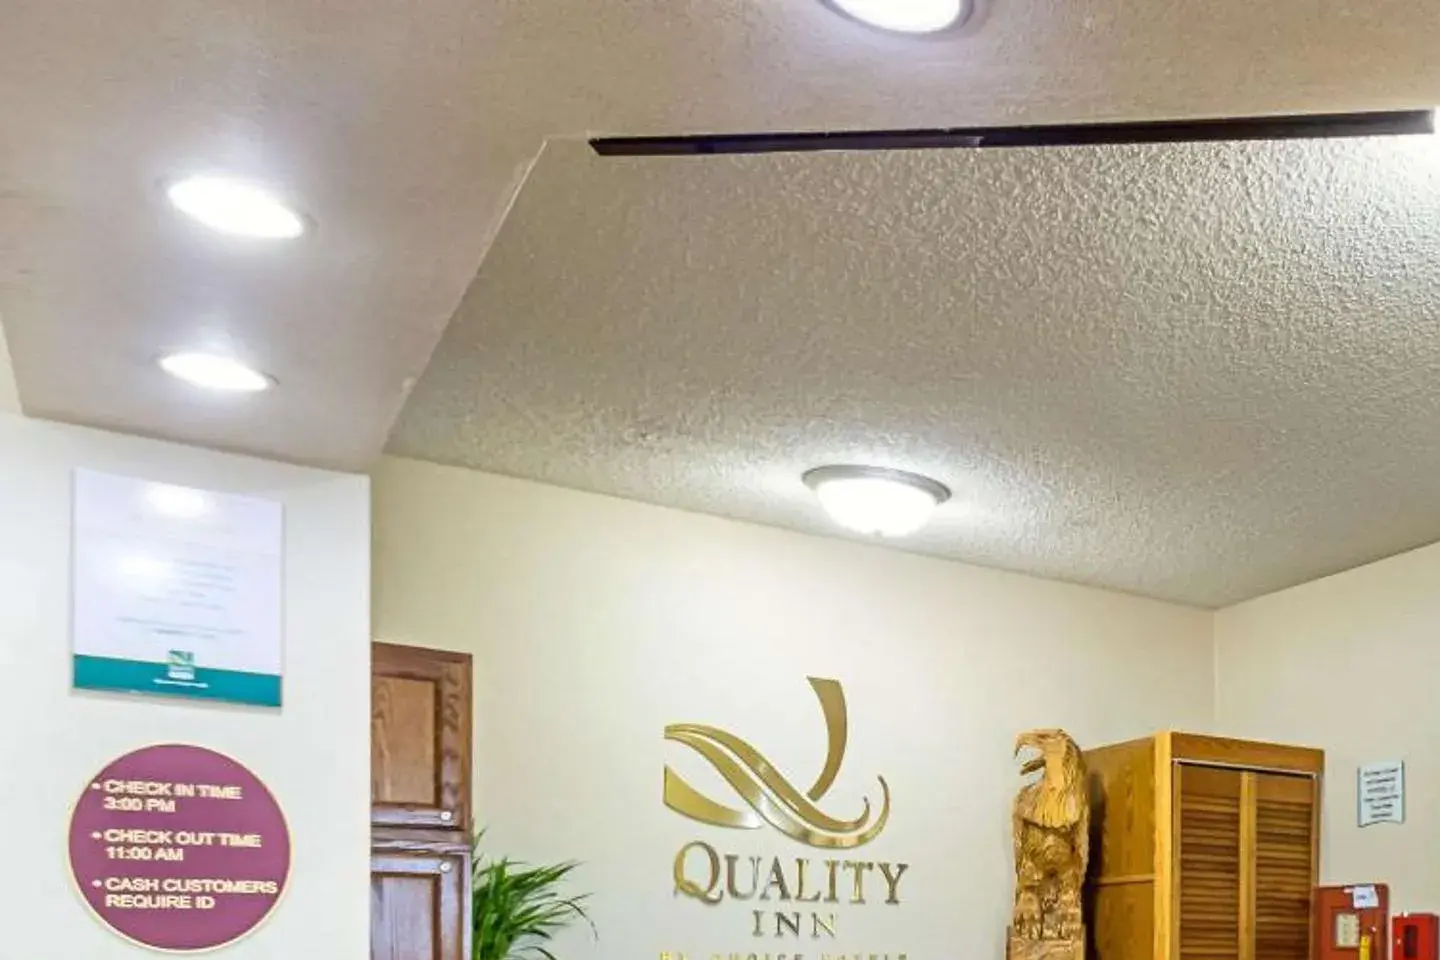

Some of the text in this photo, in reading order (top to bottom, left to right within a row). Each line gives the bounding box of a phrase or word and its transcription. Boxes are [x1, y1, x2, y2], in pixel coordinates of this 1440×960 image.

[103, 779, 243, 800] CHECK IN TIME
[103, 797, 176, 813] 3:00 PM
[104, 829, 262, 848] CHECK OUT TIME
[105, 846, 184, 862] 11:00 AM
[673, 840, 909, 906] QUALITY
[104, 877, 278, 894] CASH CUSTOMERS
[104, 894, 215, 910] REQUIRE ID
[752, 909, 836, 938] INN
